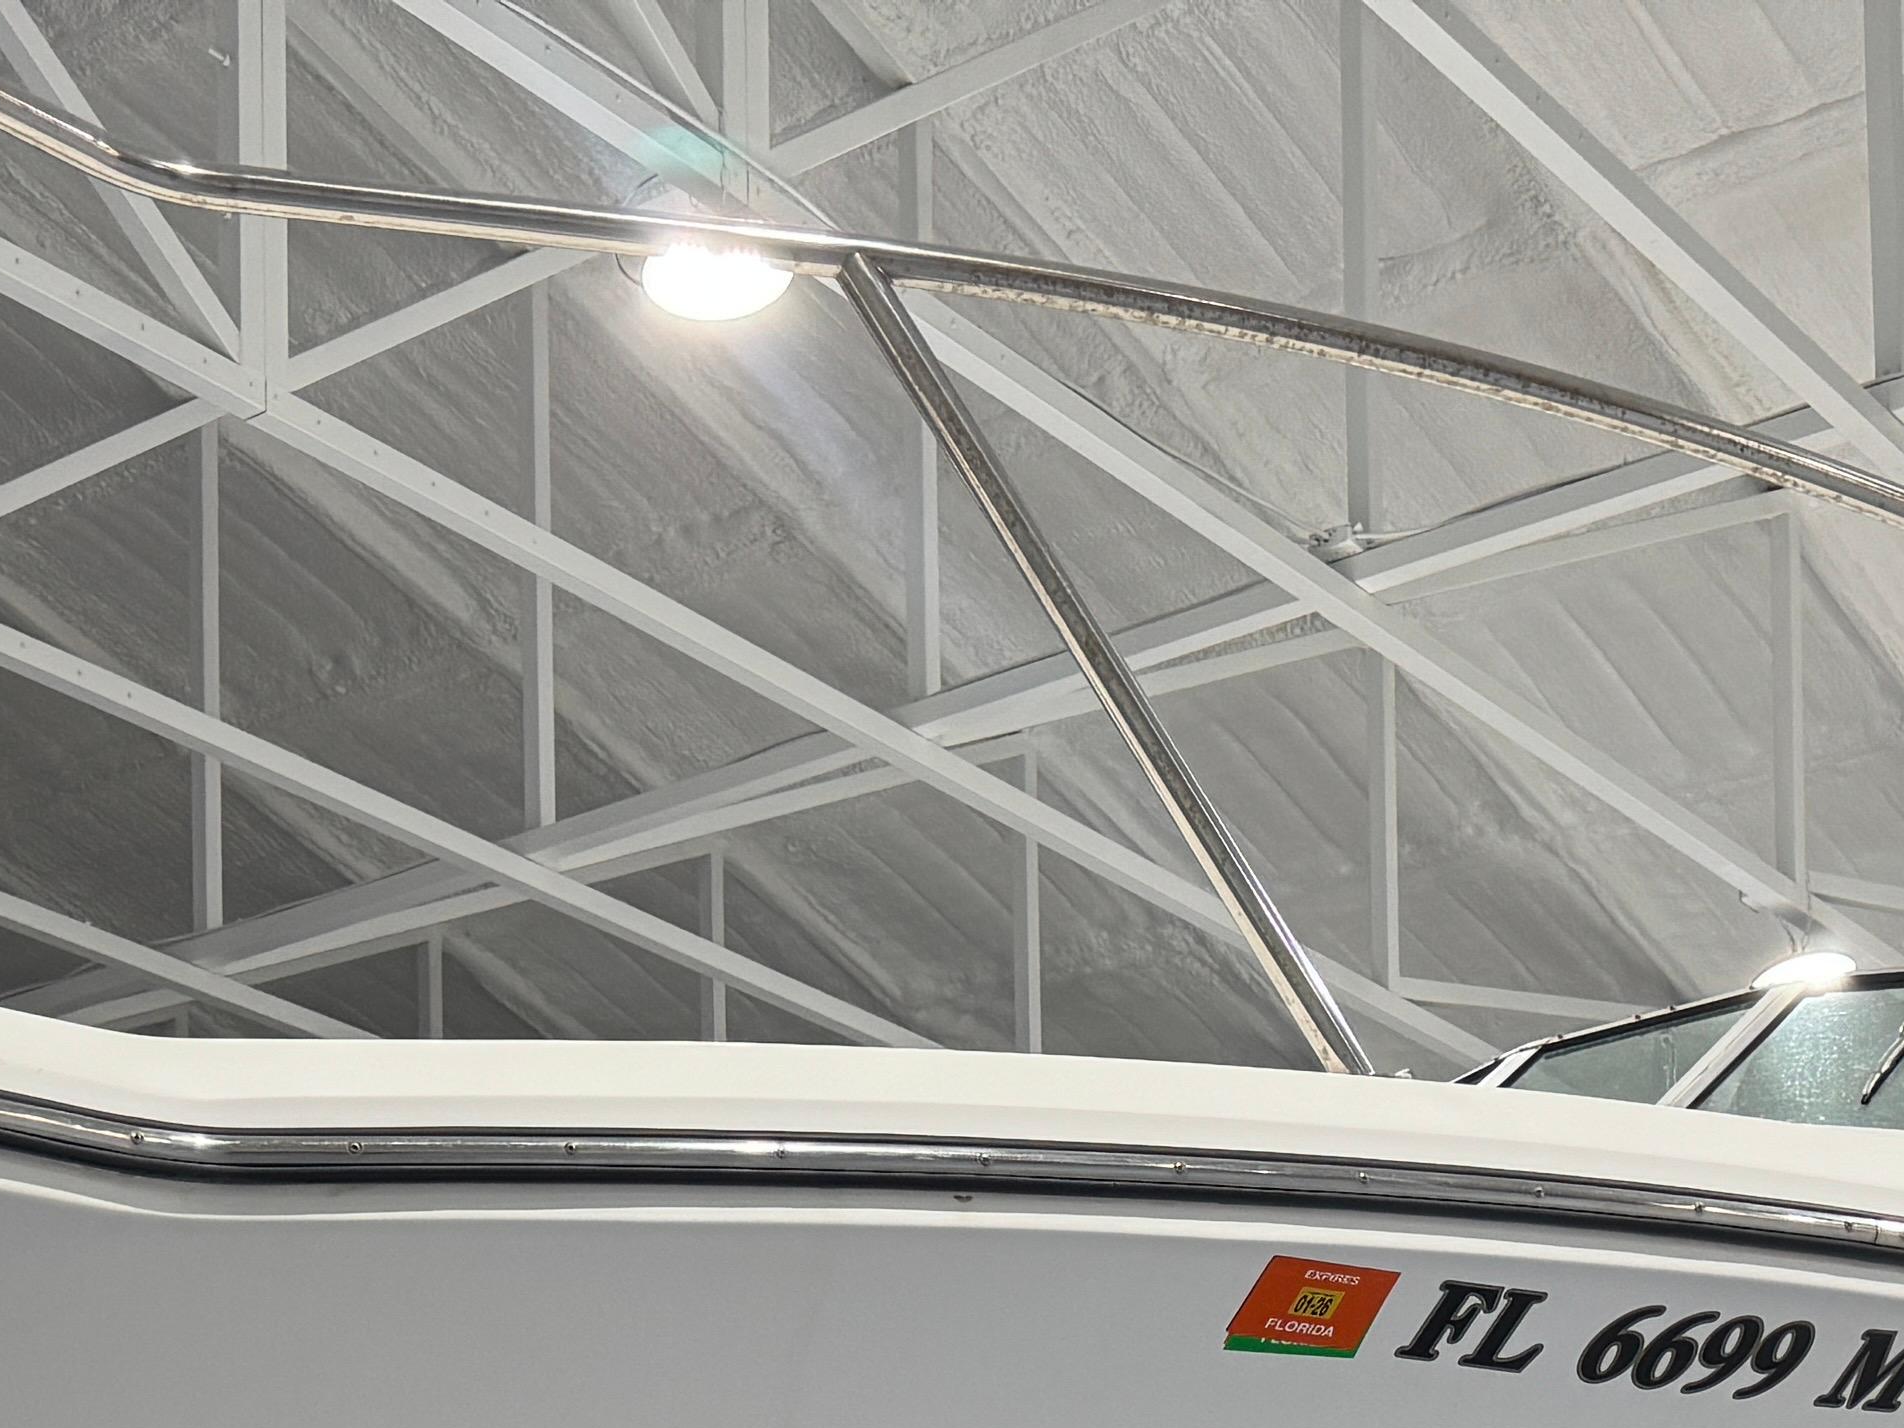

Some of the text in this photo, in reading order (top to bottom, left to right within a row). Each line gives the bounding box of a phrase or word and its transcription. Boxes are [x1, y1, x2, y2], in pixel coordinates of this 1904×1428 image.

[1304, 1269, 1361, 1286] EXPIRES
[1264, 1317, 1335, 1338] FLORIDA
[1395, 1279, 1548, 1373] FL
[1576, 1304, 1815, 1400] 6699
